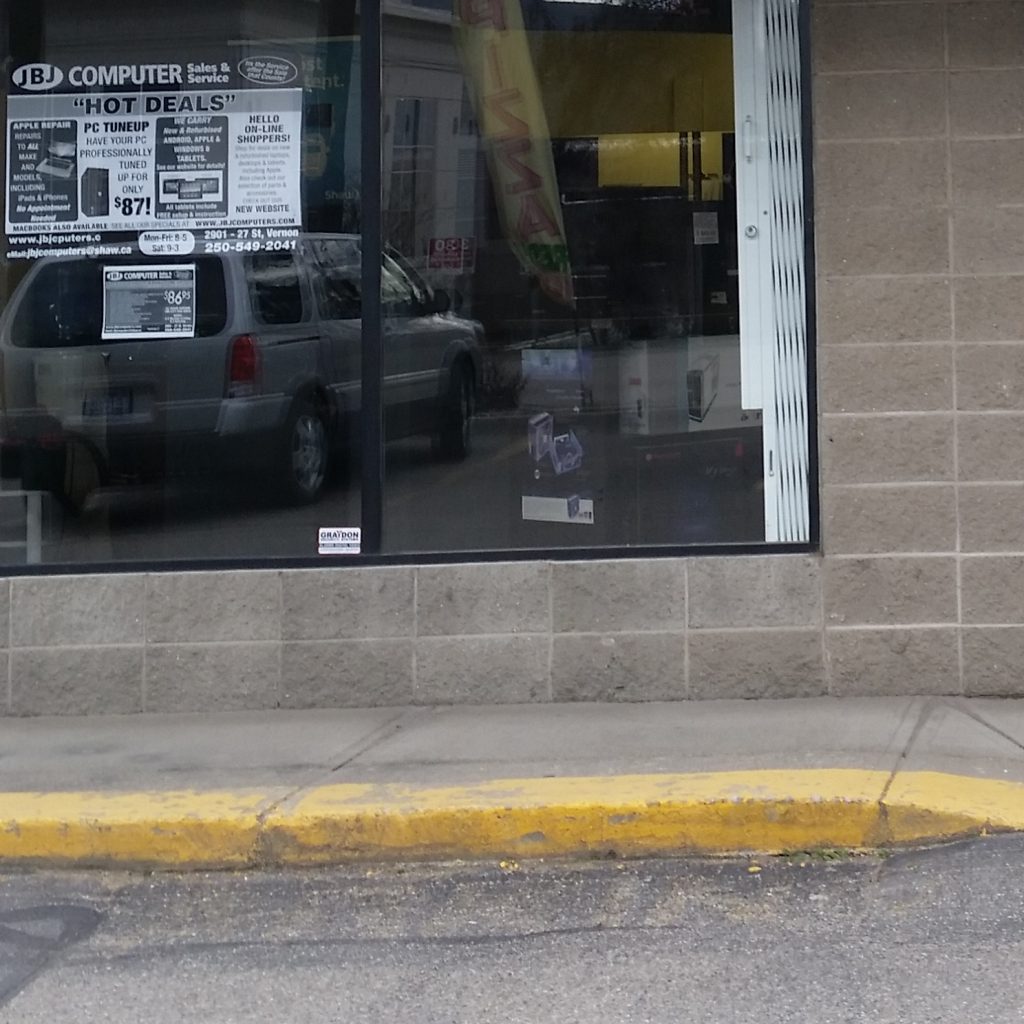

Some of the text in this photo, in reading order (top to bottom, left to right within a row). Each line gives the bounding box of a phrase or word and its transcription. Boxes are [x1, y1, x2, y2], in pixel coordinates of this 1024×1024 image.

[187, 62, 230, 74] Sales &
[18, 64, 182, 87] JBJ COMPUTER
[187, 74, 229, 84] Service
[250, 115, 280, 124] HELLO
[84, 121, 149, 133] PC TUNEUP
[245, 125, 284, 133] ON-LINE
[86, 136, 147, 146] HAVE YOUR PC
[237, 134, 291, 143] SHOPPERS!
[80, 148, 153, 158] PROFESSIONALLY
[120, 161, 147, 169] TUNED
[132, 173, 148, 181] FOR
[10, 184, 46, 192] INCLUDING
[122, 186, 144, 194] ONLY
[114, 196, 151, 216] $87!
[236, 204, 289, 213] NEW WEBSITE
[195, 218, 295, 227] WWW.JBJCOMPUTERS.COM
[204, 230, 227, 240] 2901
[236, 230, 249, 240] 27
[266, 229, 299, 239] Vernon
[204, 240, 297, 253] 250-549-2041
[124, 272, 158, 280] COMPUTER
